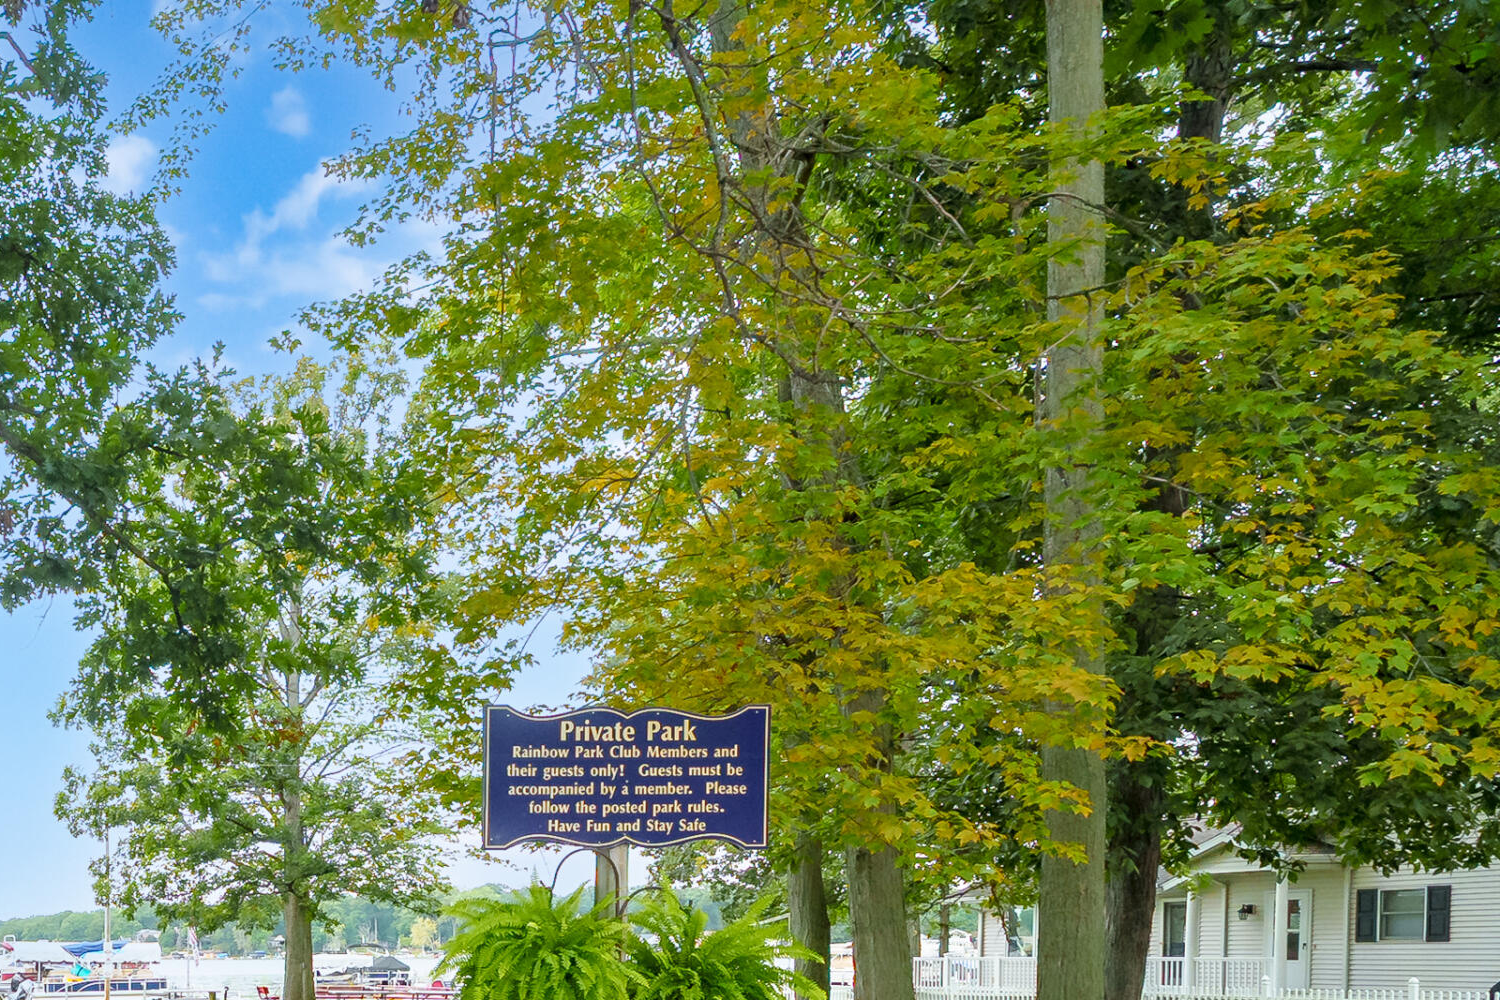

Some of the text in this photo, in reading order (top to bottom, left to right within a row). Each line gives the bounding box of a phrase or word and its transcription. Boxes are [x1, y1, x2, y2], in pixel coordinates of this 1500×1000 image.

[560, 720, 697, 742] Private Park
[512, 745, 738, 758] Rainbow Park Club Members and
[507, 764, 743, 780] their guests only! Guests must be
[508, 782, 747, 798] accompanied by a member. Please
[529, 801, 725, 817] follow the posted park rules.
[548, 818, 706, 835] Have Fun and Stay Safe
